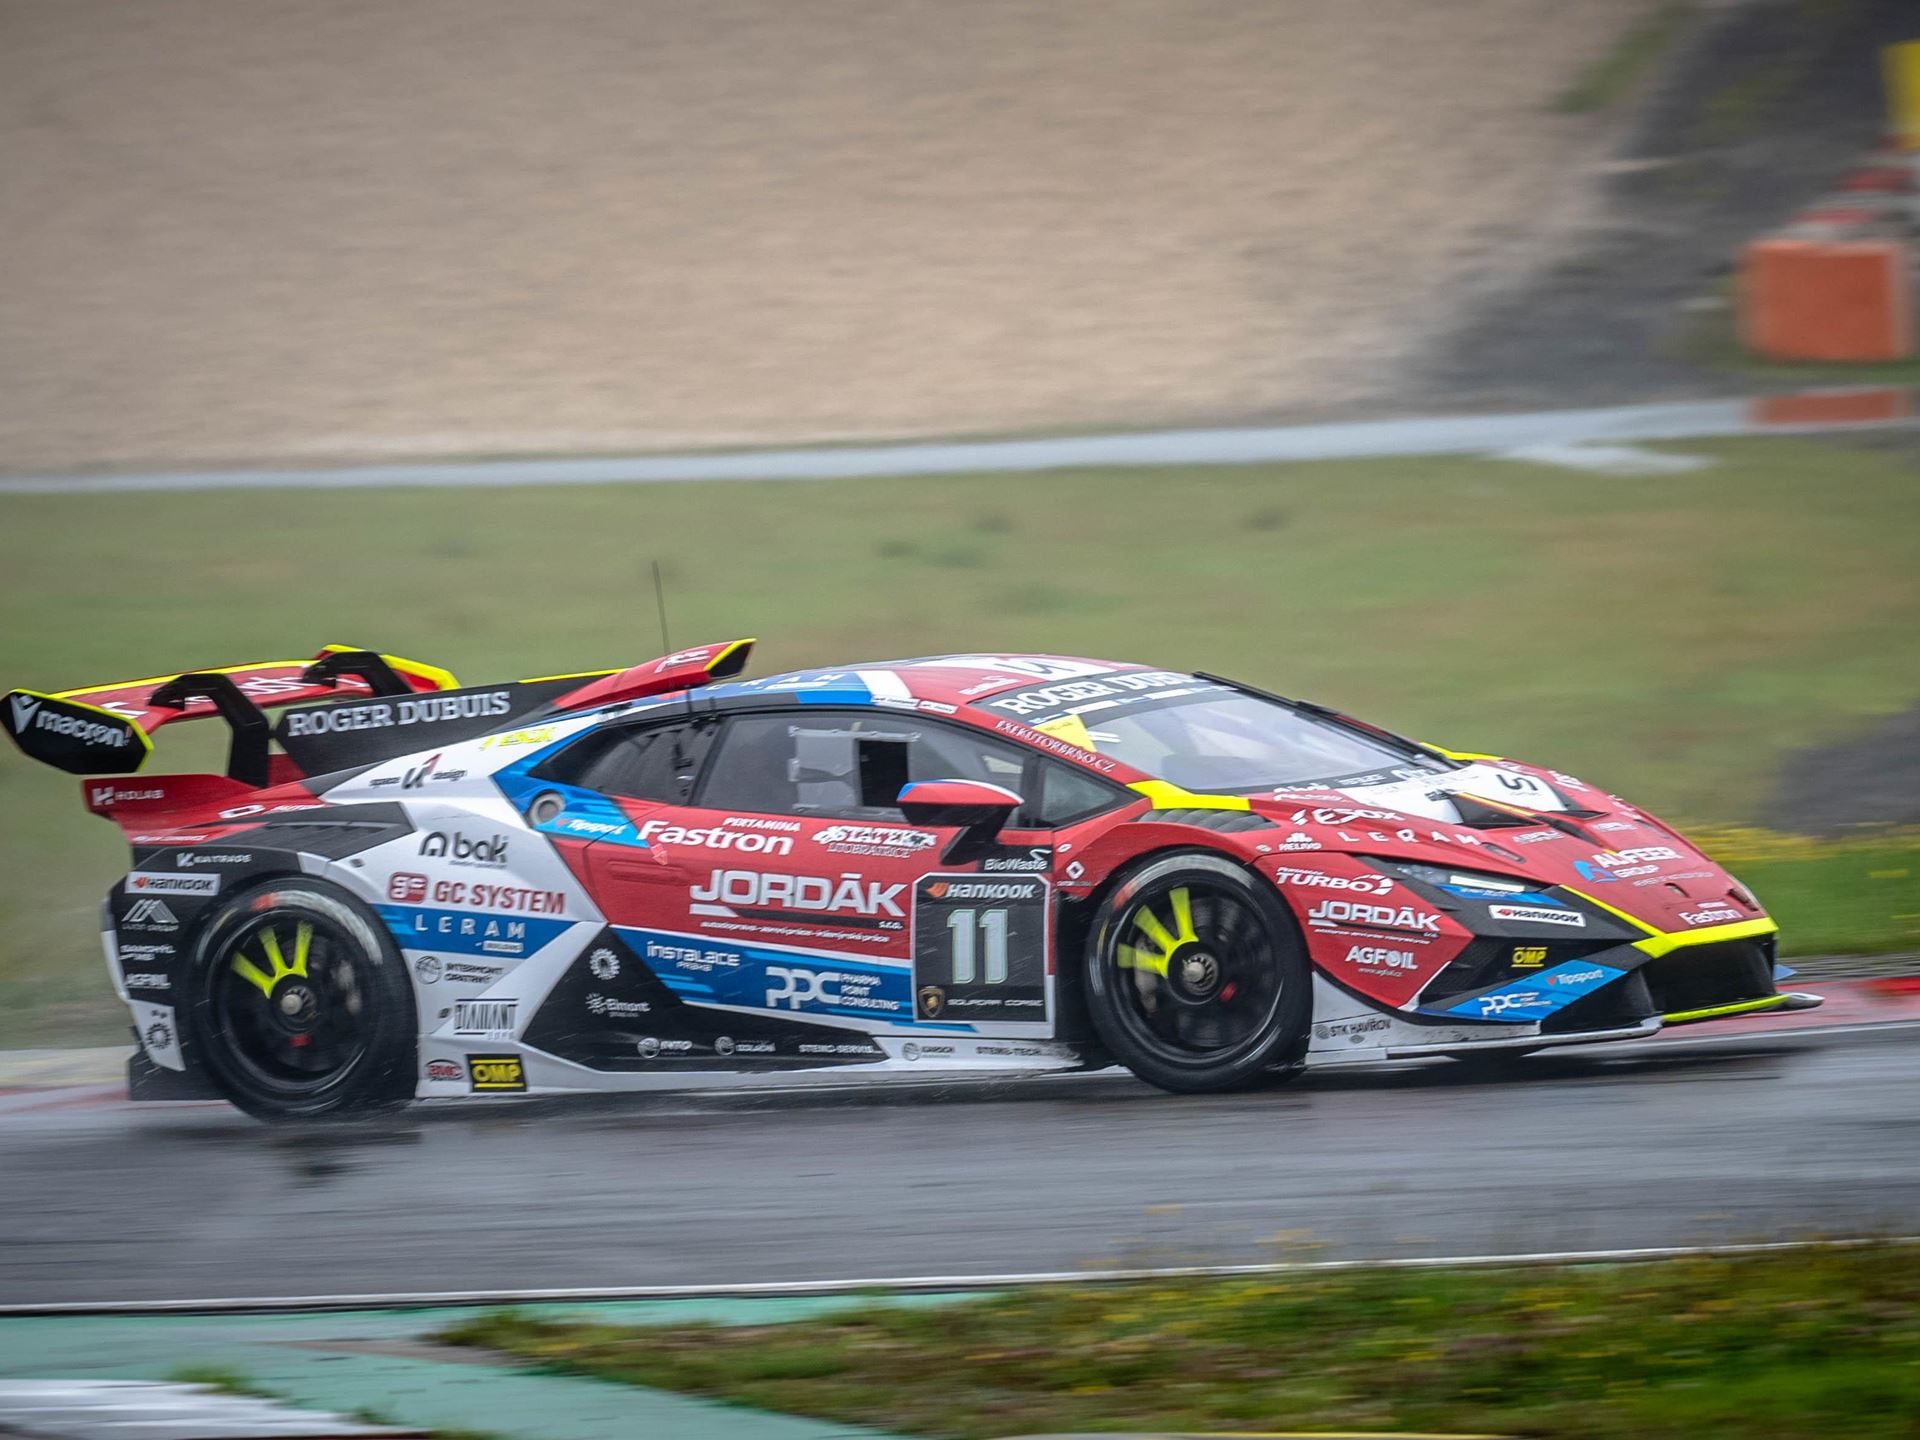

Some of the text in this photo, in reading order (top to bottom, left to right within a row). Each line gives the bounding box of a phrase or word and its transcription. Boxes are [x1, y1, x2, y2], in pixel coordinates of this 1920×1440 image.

[288, 704, 393, 737] ROGER
[397, 692, 511, 725] DUBUIS
[637, 821, 793, 855] Fastron
[435, 881, 565, 914] GC SYSTEM
[416, 914, 525, 939] LERAM
[947, 909, 1008, 984] 11
[1345, 946, 1419, 969] AGFOIL
[1513, 951, 1547, 964] OMP
[766, 966, 842, 1010] PPC
[1557, 969, 1604, 985] Tipsport
[1478, 993, 1521, 1016] PPC
[473, 1064, 521, 1083] OMP
